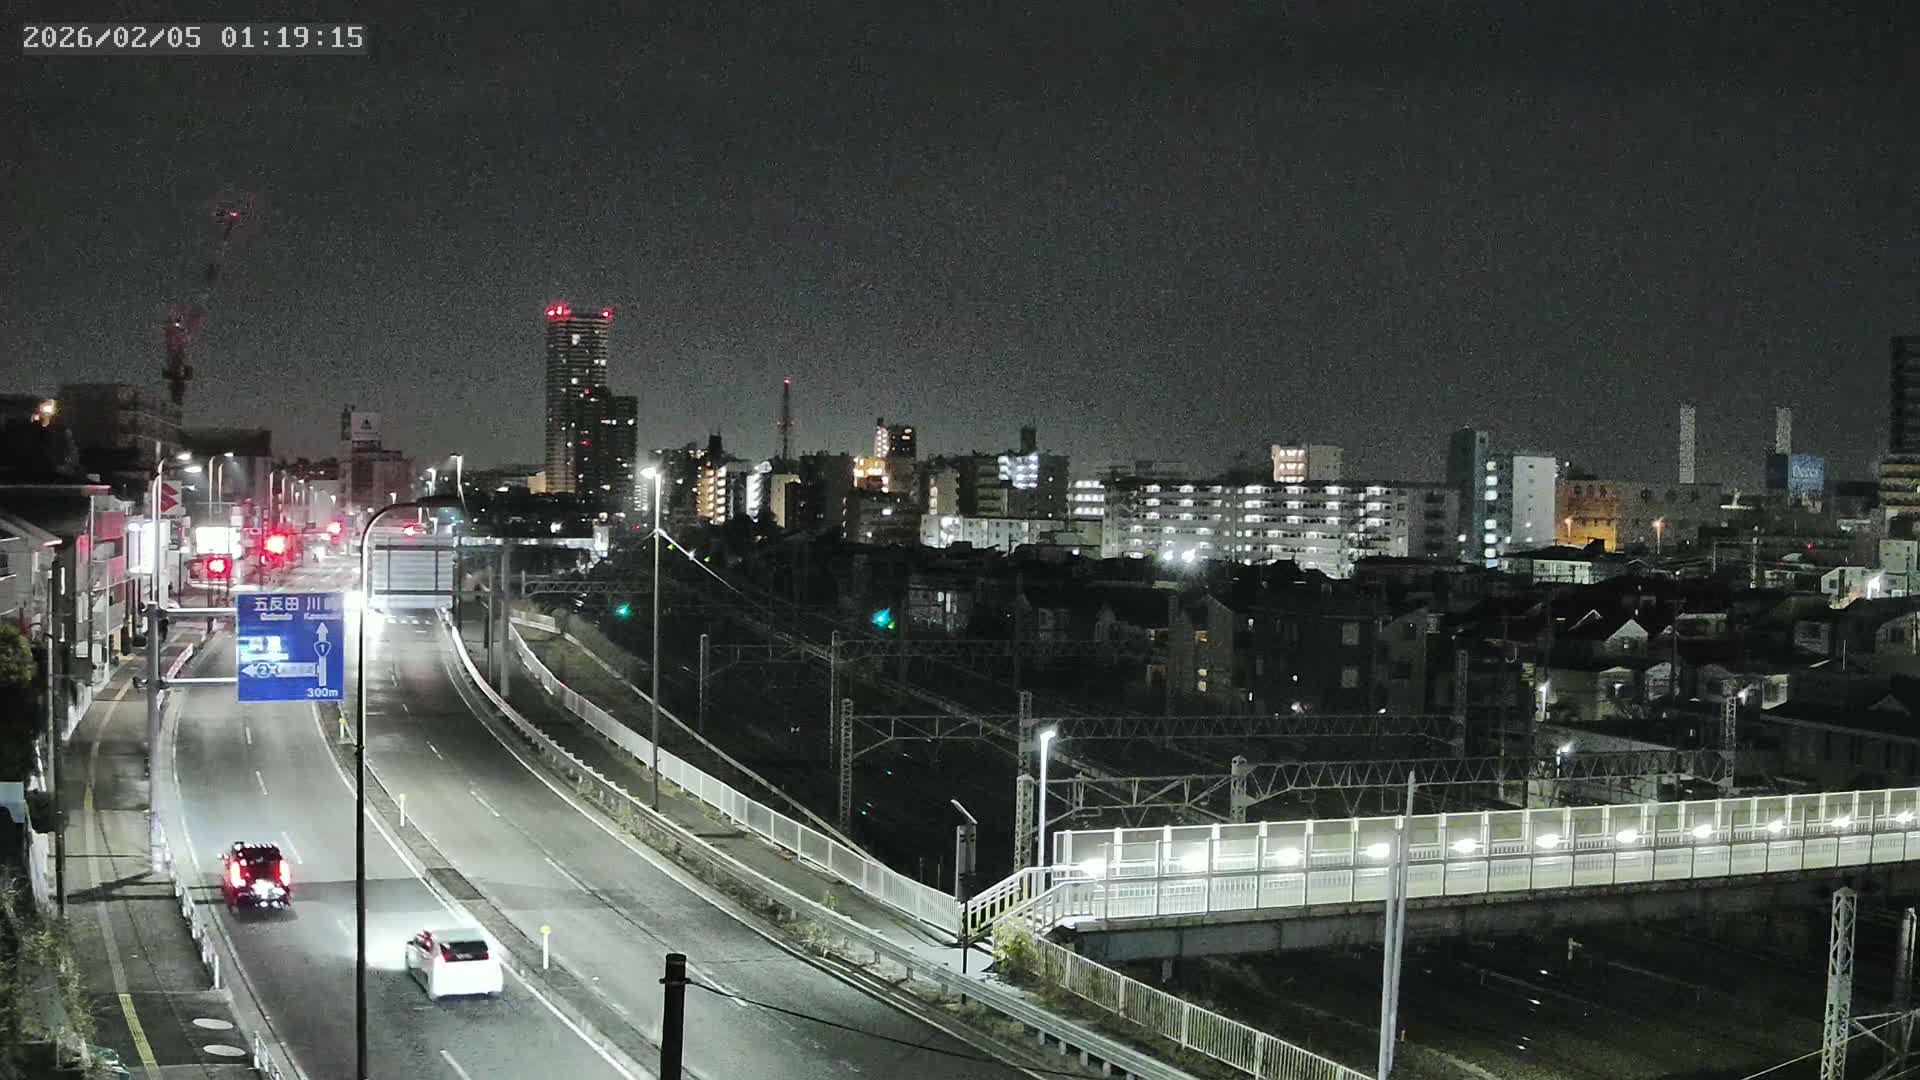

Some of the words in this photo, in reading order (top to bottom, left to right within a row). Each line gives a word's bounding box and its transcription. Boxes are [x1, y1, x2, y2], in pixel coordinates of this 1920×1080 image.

[253, 596, 299, 611] 五反田
[306, 687, 338, 697] 300m
